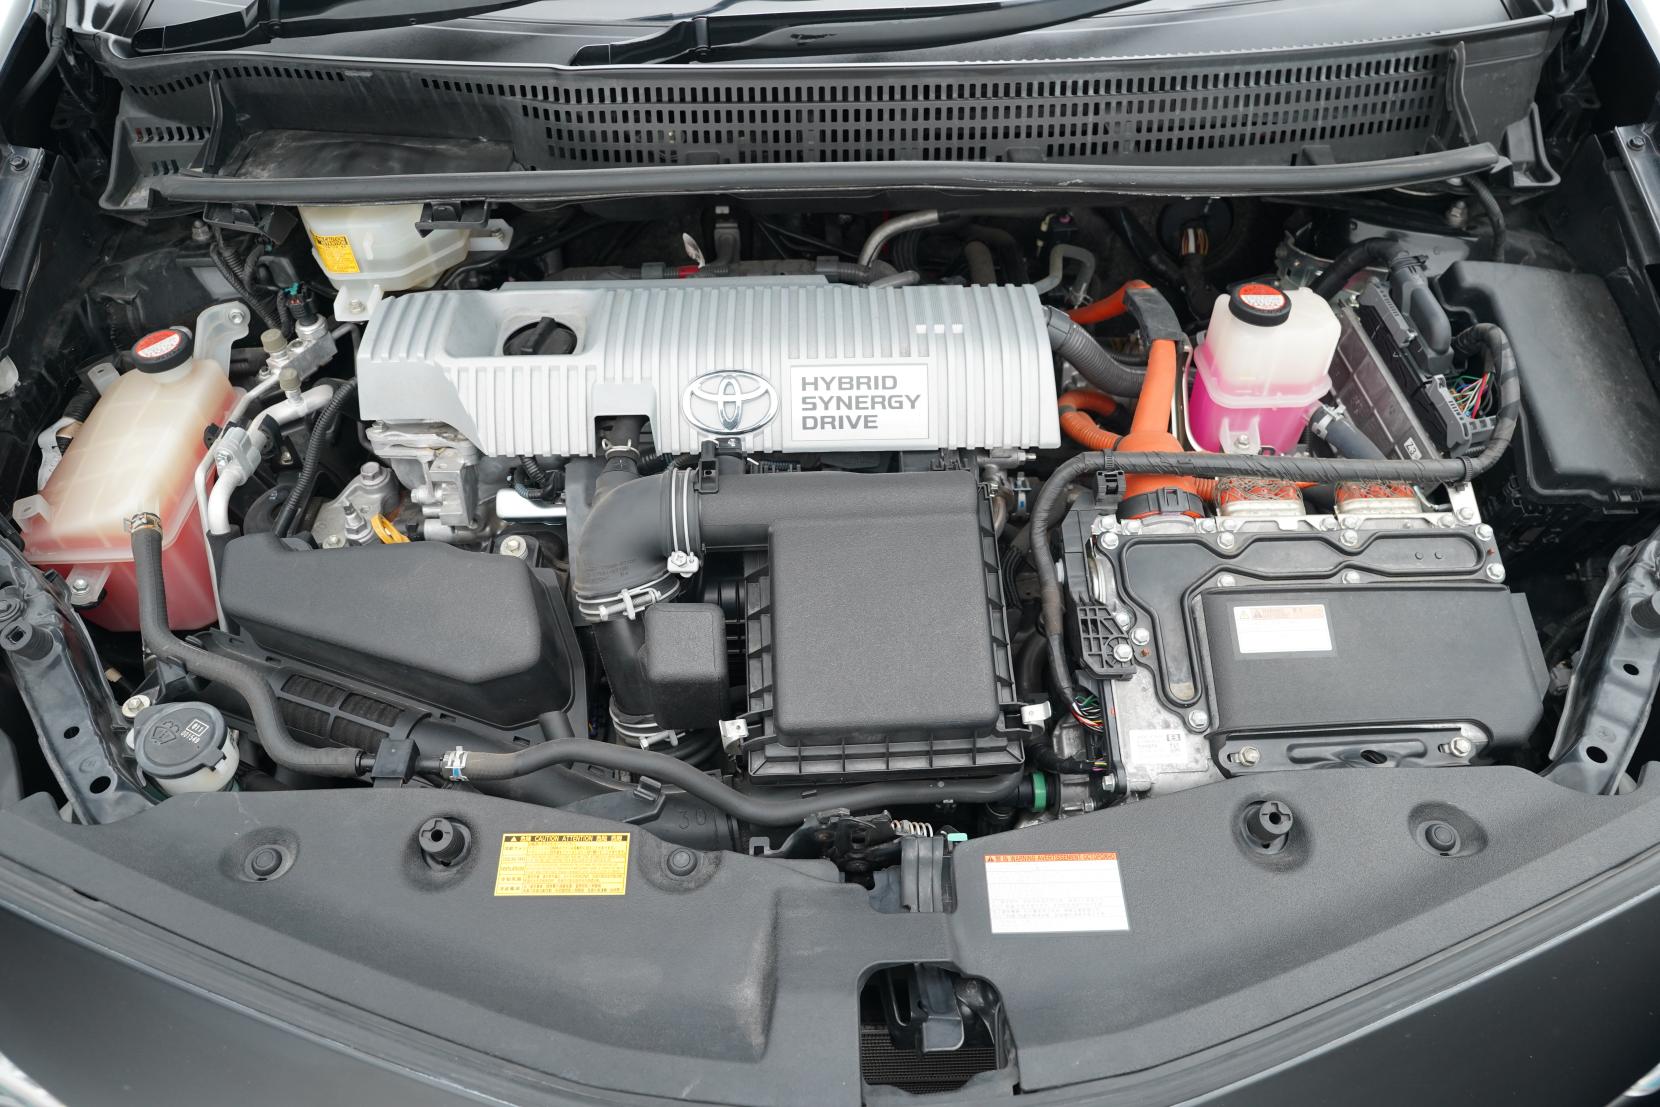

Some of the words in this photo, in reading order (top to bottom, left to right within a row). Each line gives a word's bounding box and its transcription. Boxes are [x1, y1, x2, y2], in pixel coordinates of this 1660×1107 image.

[801, 375, 898, 391] HYBRID
[801, 394, 921, 411] SYNERGY
[802, 414, 879, 430] DRIVE
